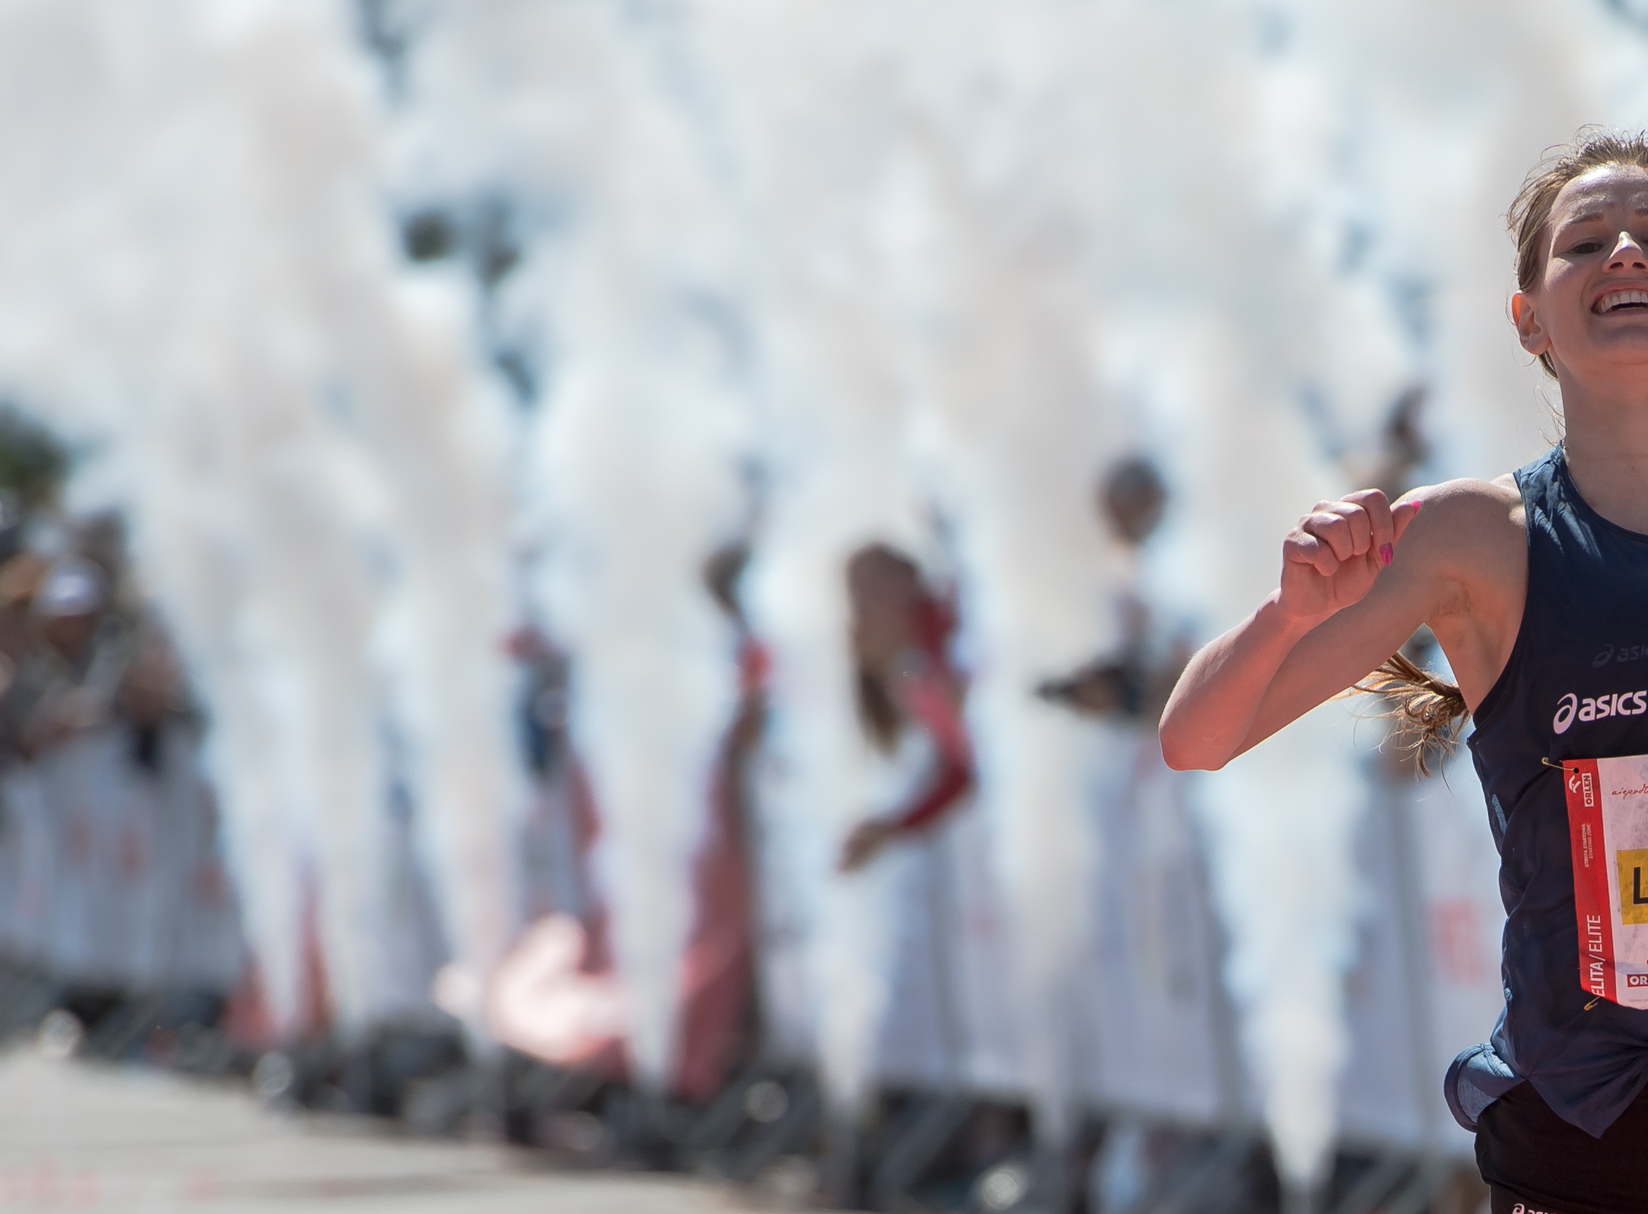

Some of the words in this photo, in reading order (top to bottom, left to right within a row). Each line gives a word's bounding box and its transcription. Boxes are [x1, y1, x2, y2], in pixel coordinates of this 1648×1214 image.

[1579, 691, 1647, 722] asics
[1583, 774, 1593, 805] ORLEN
[1586, 914, 1606, 997] ELITA/ELITE
